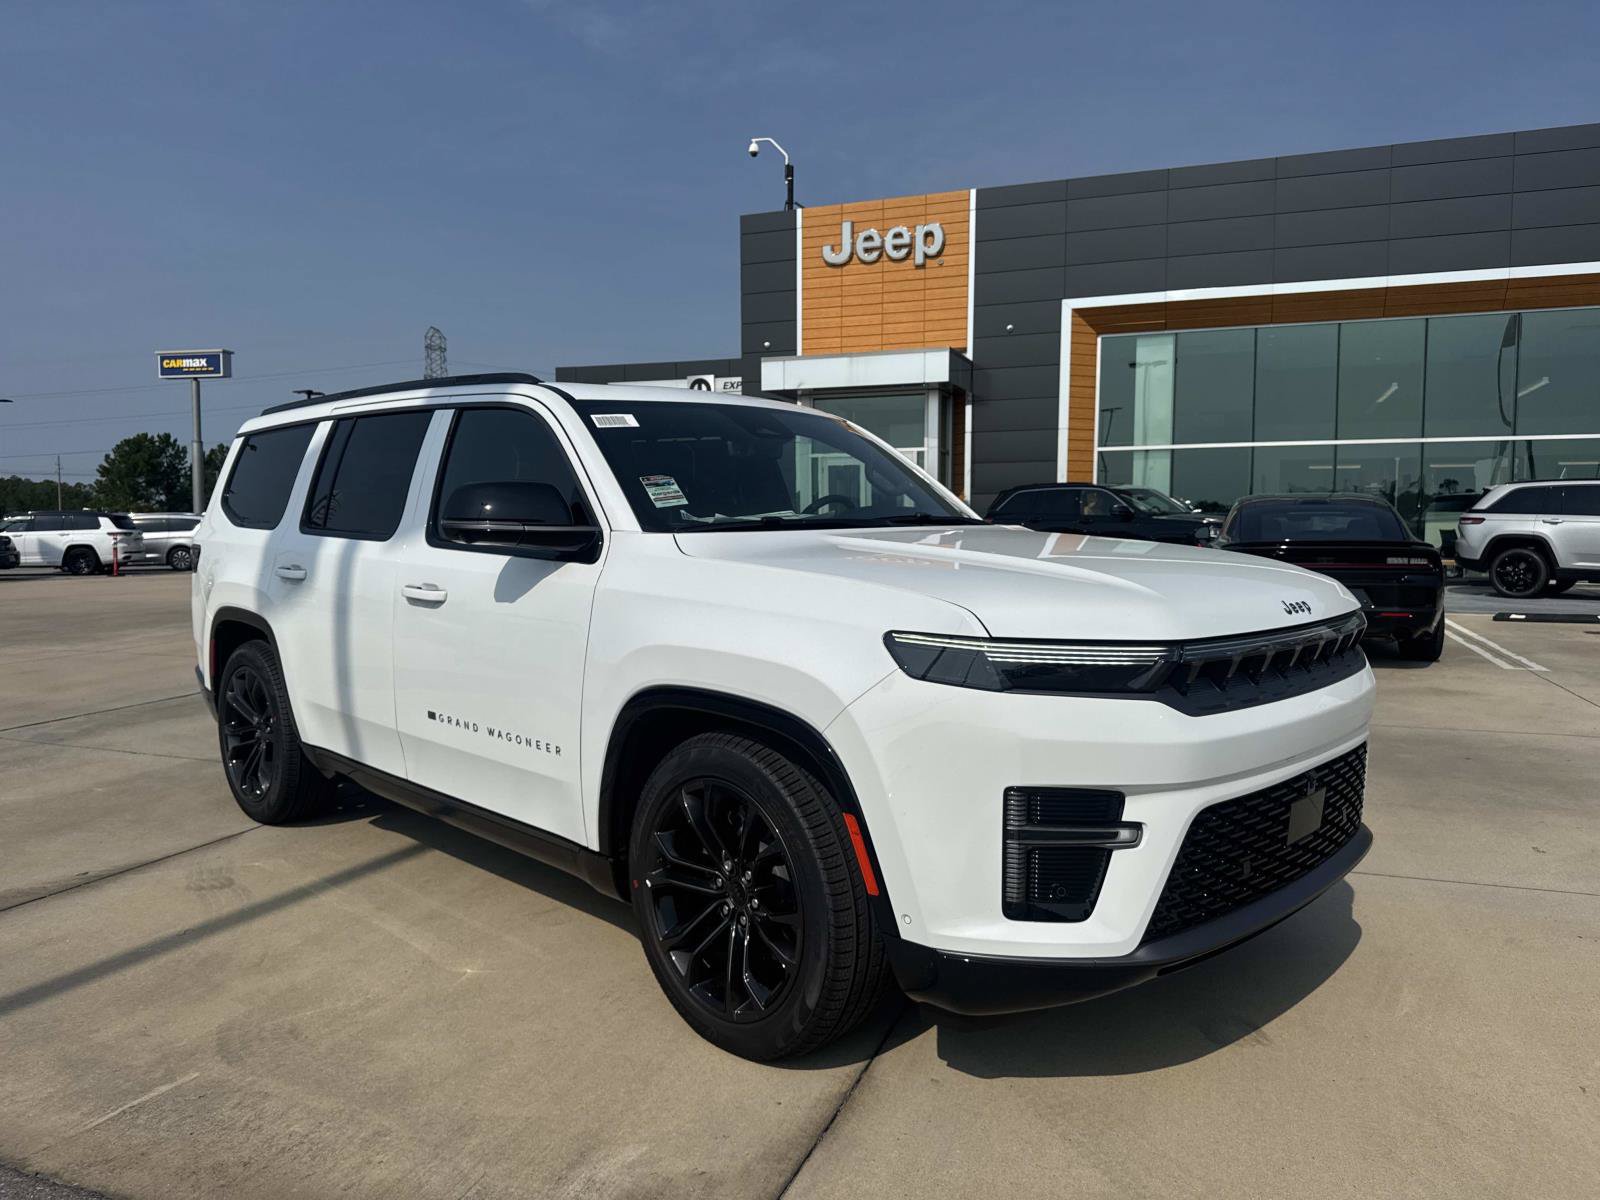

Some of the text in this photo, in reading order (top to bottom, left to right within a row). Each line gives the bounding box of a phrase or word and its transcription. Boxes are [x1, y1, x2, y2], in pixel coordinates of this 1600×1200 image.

[822, 220, 945, 267] Jeep
[1281, 600, 1312, 615] Jeep
[438, 713, 561, 757] GRAND WAGONEER
